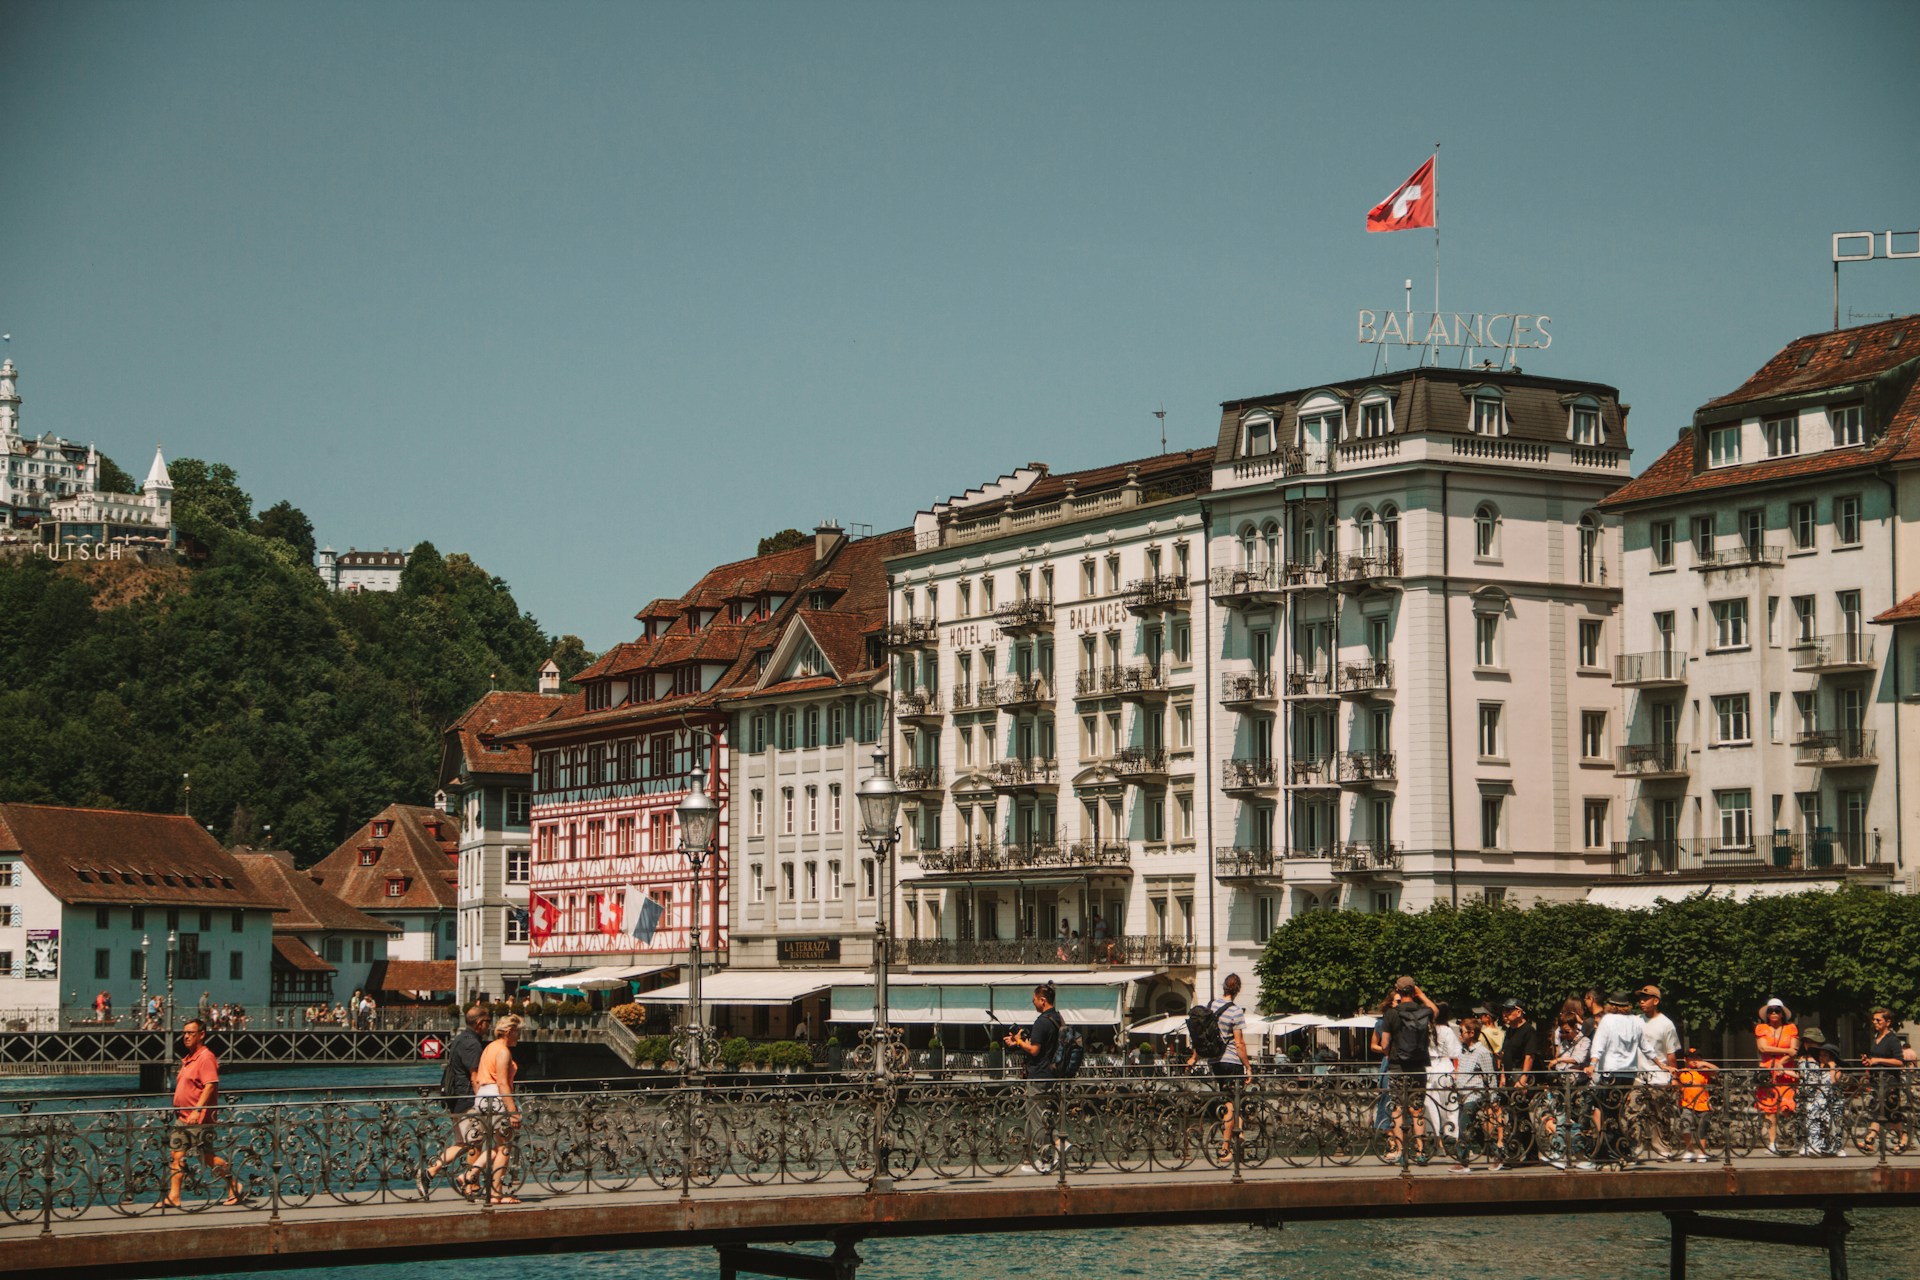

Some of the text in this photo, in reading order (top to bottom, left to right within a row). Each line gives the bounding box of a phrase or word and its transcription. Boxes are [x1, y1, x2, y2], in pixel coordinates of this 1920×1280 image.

[1359, 309, 1552, 349] BALANCES
[950, 625, 981, 647] HOTEL
[1070, 602, 1128, 630] BALANCES
[784, 941, 830, 952] LA TERRAZZA
[790, 951, 825, 960] RISTORANTE
